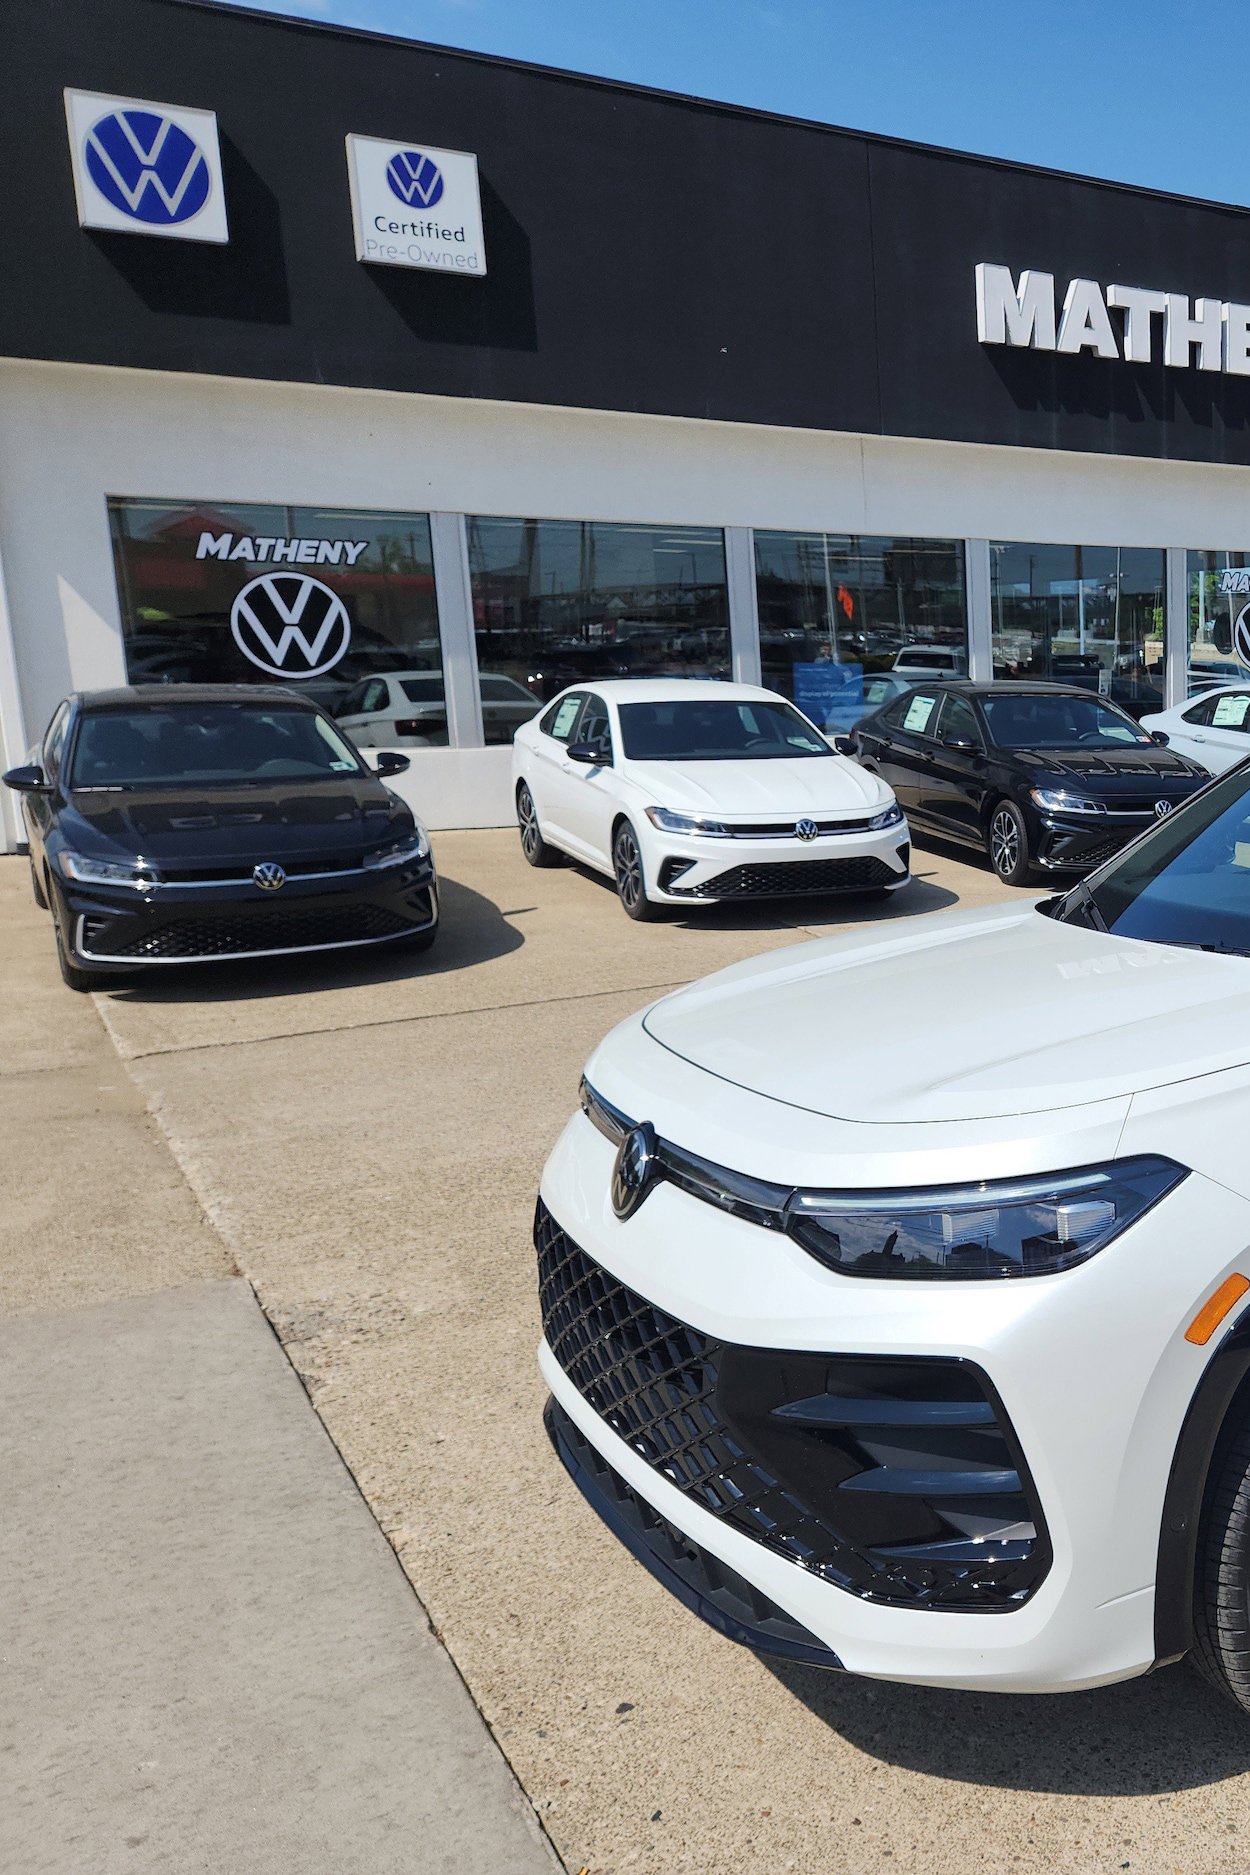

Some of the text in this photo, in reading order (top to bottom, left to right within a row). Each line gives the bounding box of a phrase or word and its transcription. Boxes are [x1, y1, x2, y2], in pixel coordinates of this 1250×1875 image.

[374, 216, 465, 242] Certified
[366, 239, 478, 268] Pre-Owned
[195, 531, 369, 566] MATHENY
